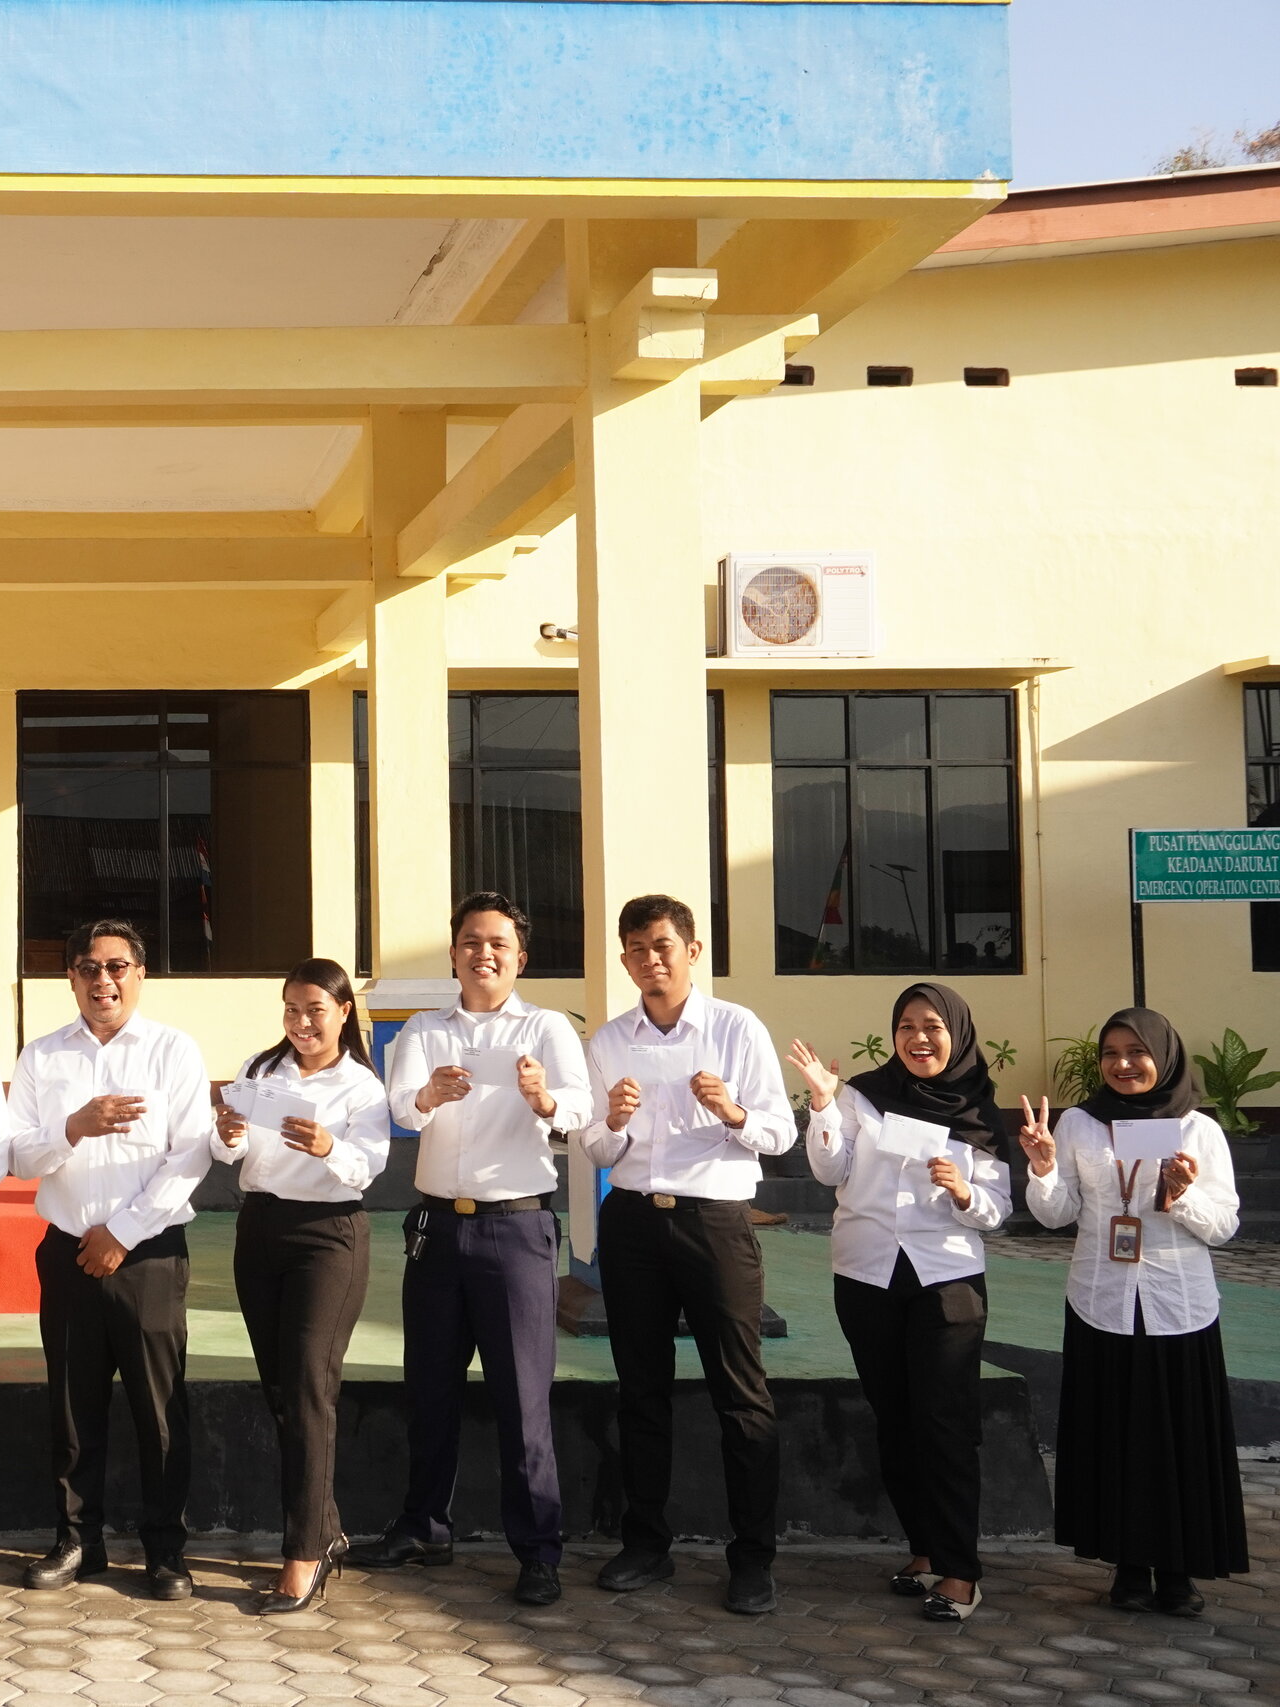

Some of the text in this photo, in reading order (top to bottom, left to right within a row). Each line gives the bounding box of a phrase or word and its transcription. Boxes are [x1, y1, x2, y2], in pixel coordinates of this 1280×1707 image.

[825, 567, 865, 575] POLYTRO
[1149, 835, 1280, 851] PUSAT PENANGGULANG
[1167, 855, 1279, 873] KEADAAN DARURAT
[1138, 880, 1195, 896] EMERGENCY
[1195, 879, 1249, 895] OPERATION
